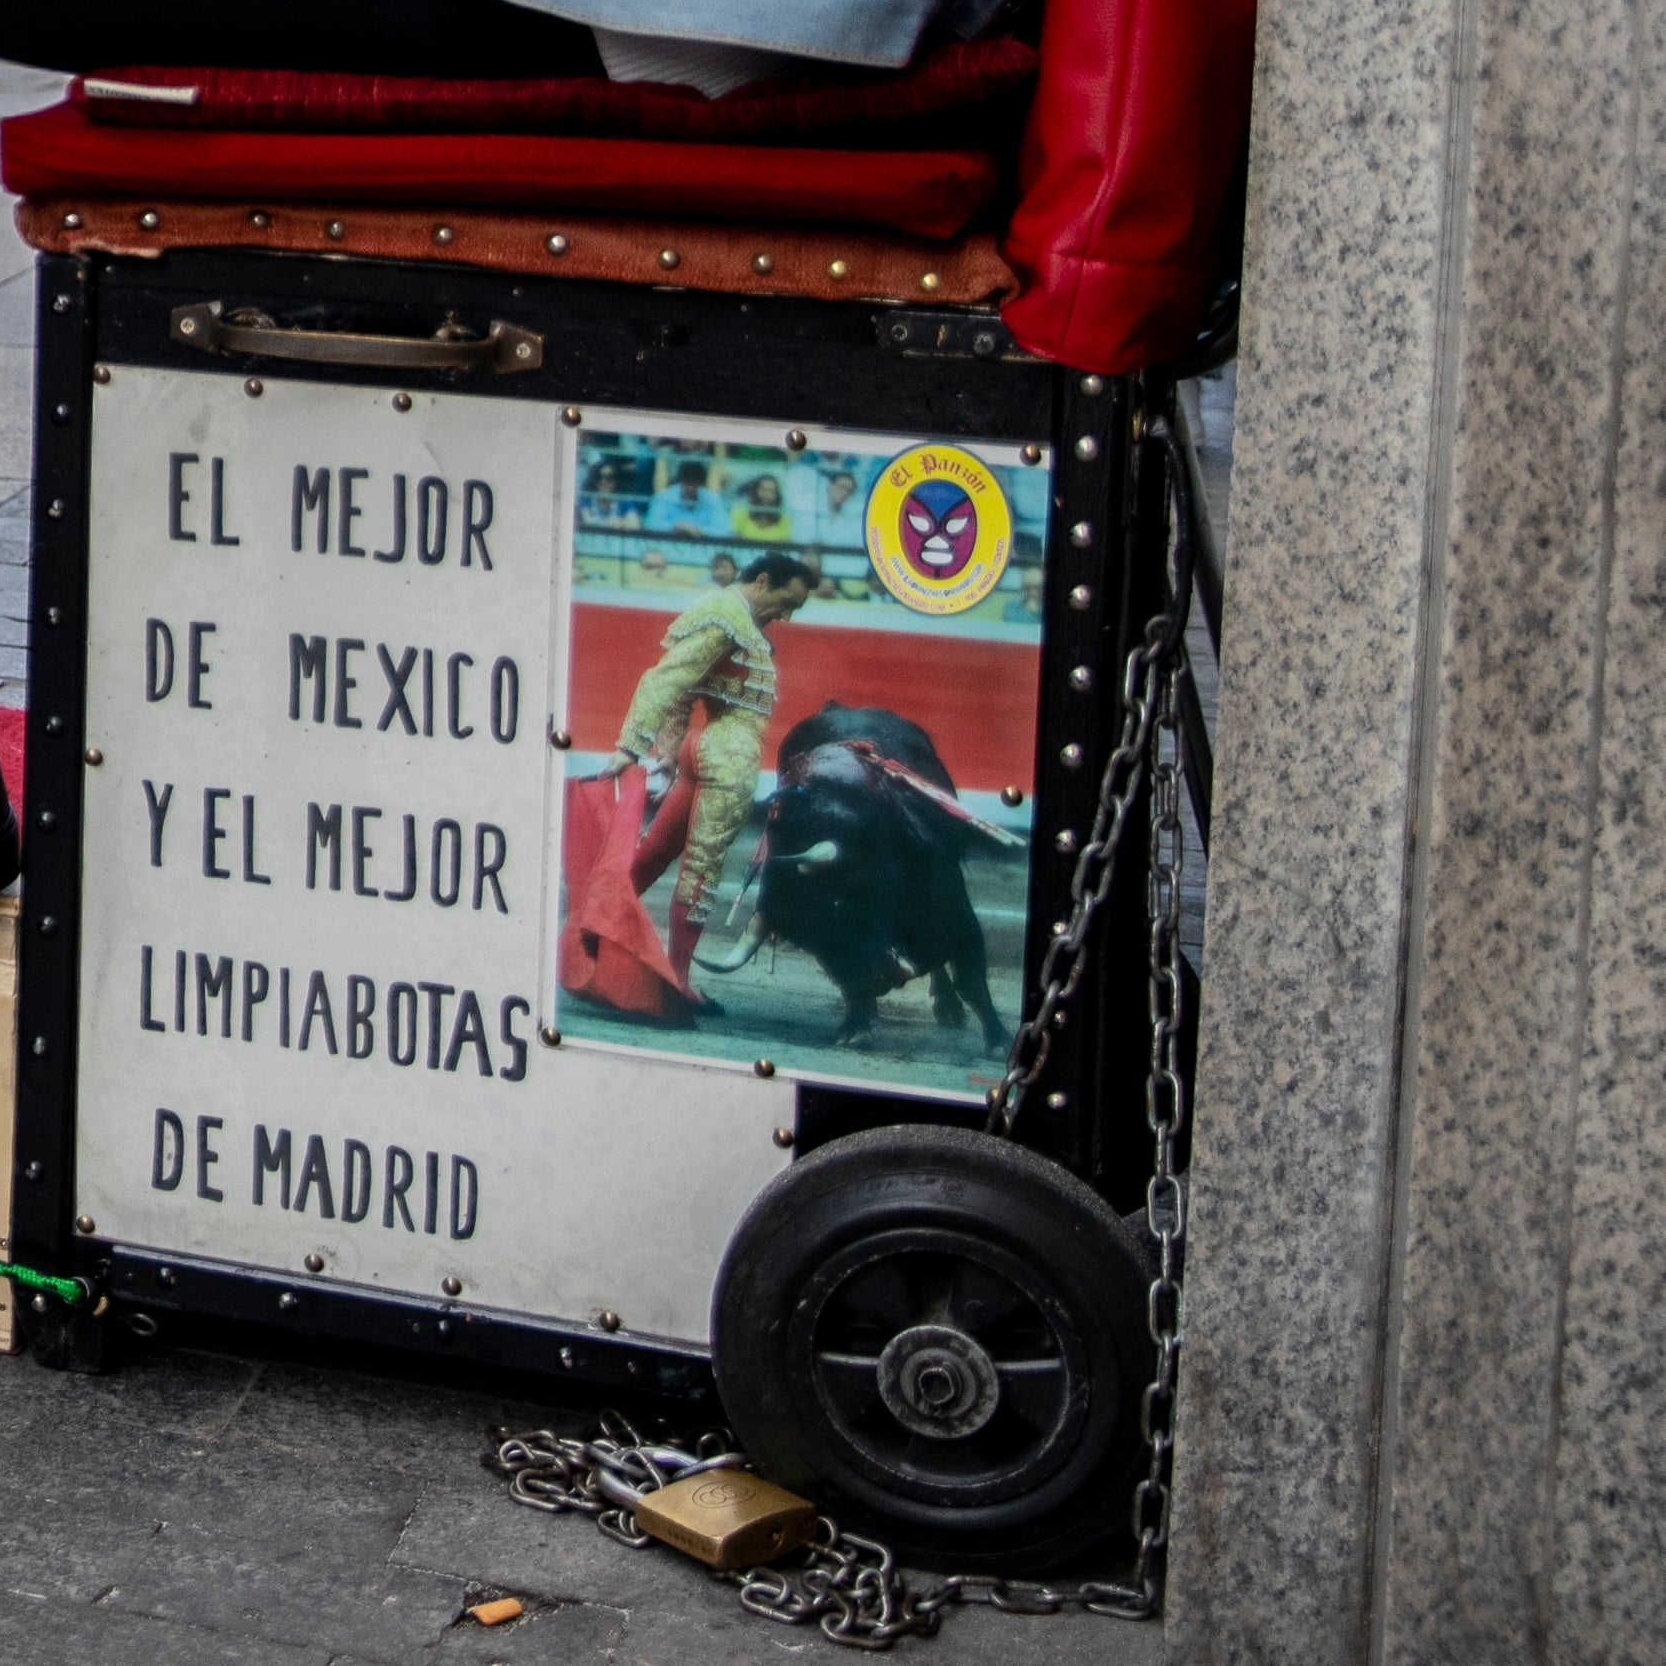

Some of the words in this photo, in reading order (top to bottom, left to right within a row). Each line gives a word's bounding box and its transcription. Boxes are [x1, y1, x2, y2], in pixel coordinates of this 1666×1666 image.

[169, 452, 241, 547] EL
[291, 464, 494, 571] MEJOR
[890, 463, 913, 487] El
[145, 617, 217, 710] DE
[288, 633, 519, 745] MEXICO
[141, 779, 174, 868] Y
[202, 787, 271, 885] EL
[305, 801, 509, 914] MEJOR
[139, 944, 531, 1082] LIMPIABOTAS
[151, 1107, 224, 1203] DE
[252, 1123, 479, 1241] MADRID
